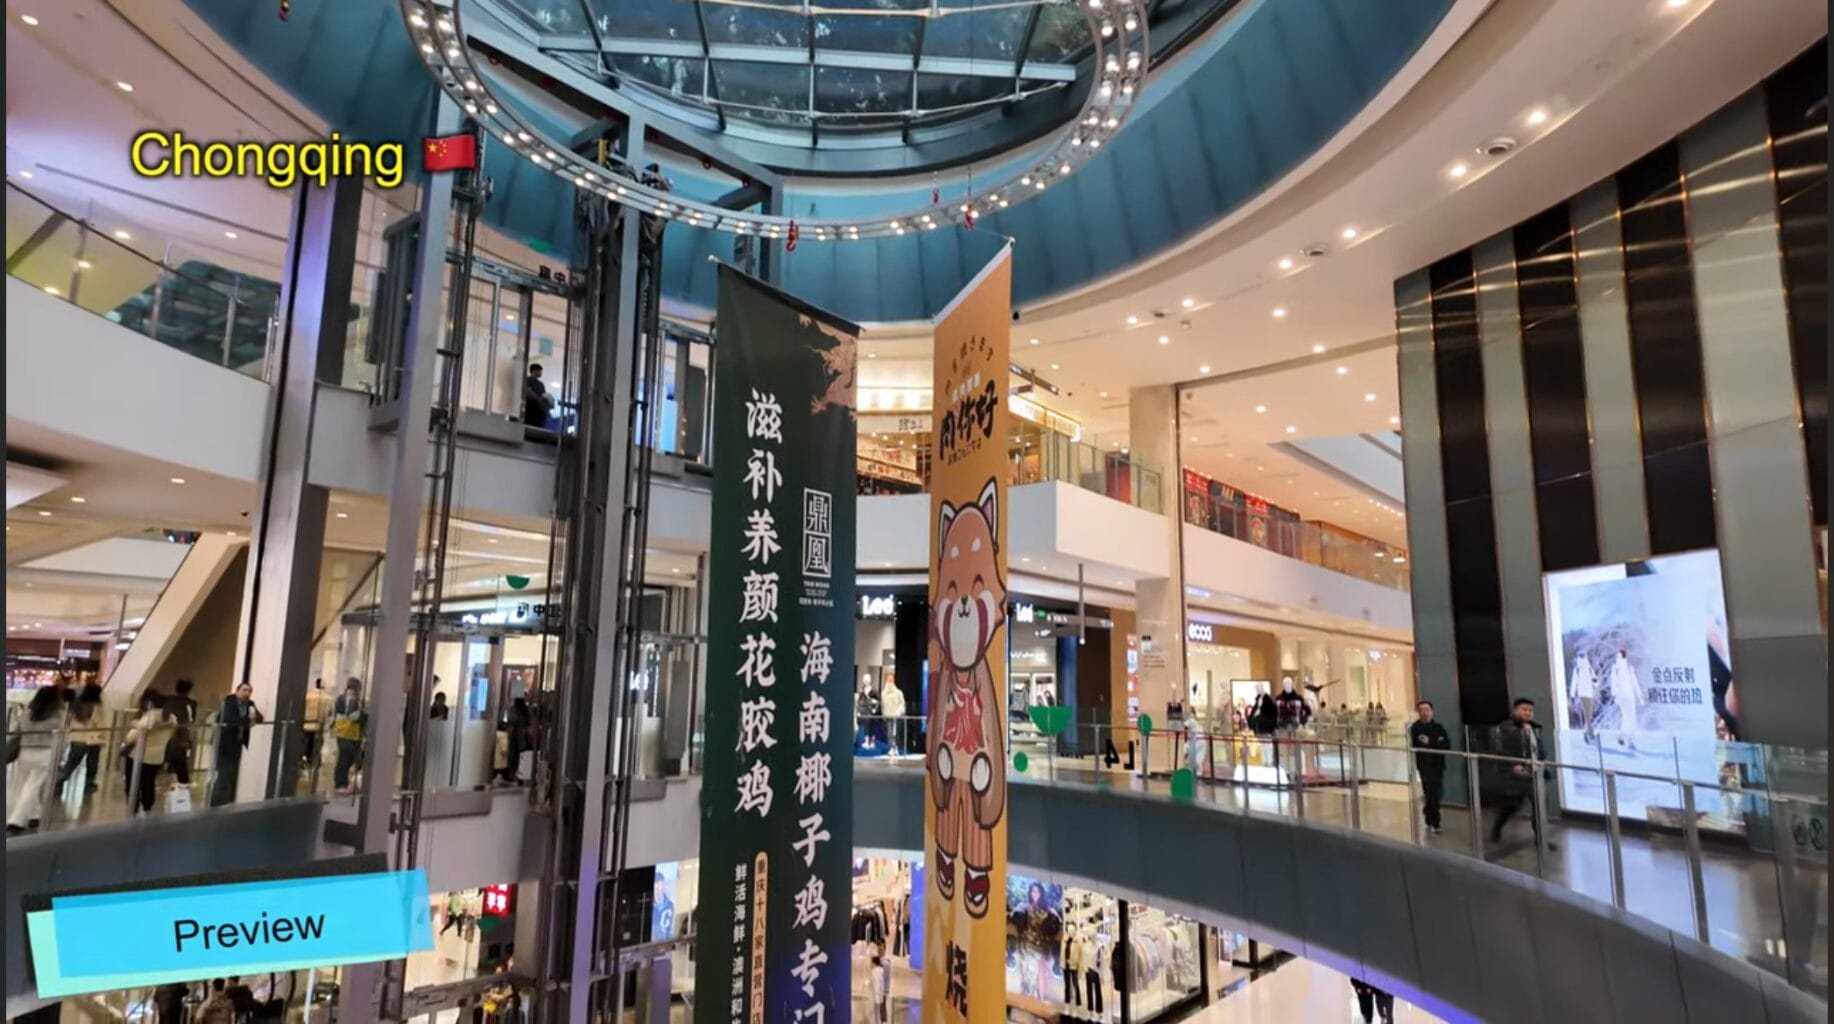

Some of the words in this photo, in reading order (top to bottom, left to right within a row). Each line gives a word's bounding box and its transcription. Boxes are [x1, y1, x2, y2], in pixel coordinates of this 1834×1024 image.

[804, 490, 831, 575] 鼎凰
[734, 387, 784, 818] 滋补养颜花胶鸡
[862, 594, 894, 615] Lee
[1188, 623, 1212, 641] ecco
[946, 940, 968, 1017] 烧
